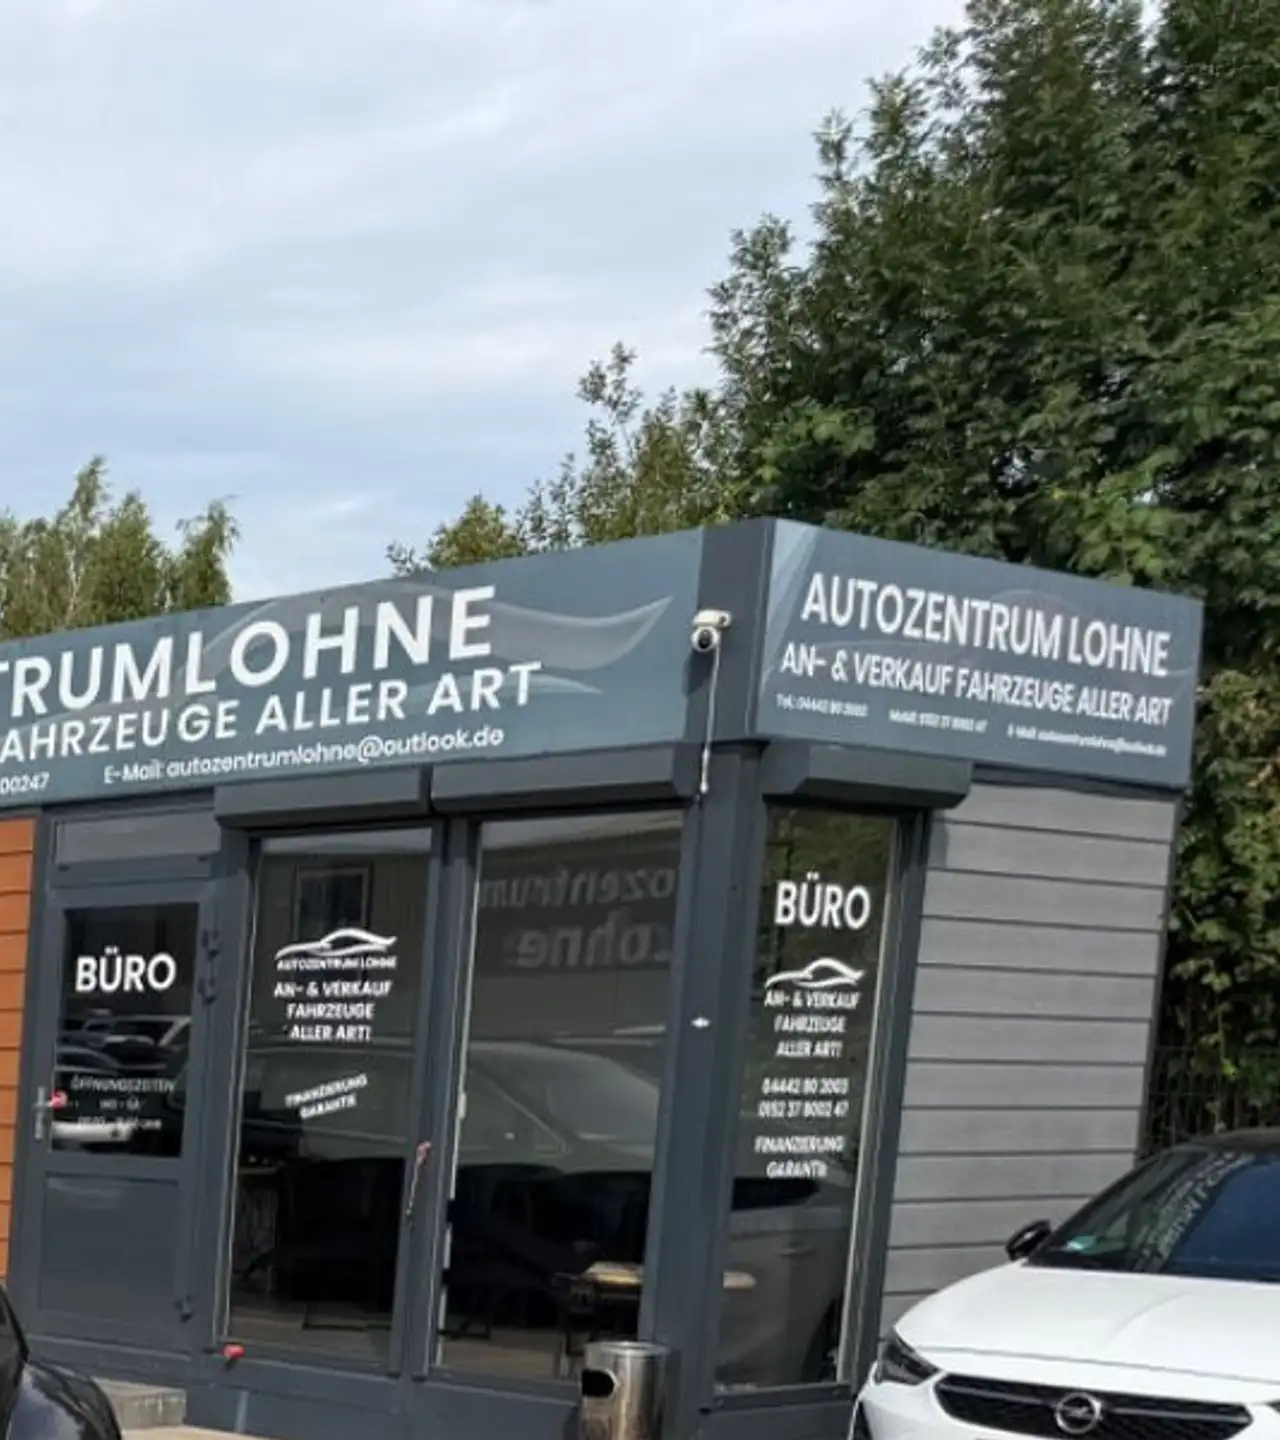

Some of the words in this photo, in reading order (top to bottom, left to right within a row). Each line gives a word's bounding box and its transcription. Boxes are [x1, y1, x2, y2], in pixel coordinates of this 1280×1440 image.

[801, 572, 1061, 660] AUTOZENTRUM
[1068, 616, 1170, 677] LOHNE
[256, 679, 408, 734] ALLER
[429, 661, 540, 715] ART
[780, 643, 827, 677] AN-
[831, 651, 848, 682] &
[854, 653, 953, 696] VERKAUF
[956, 667, 1074, 713] FAHRZEUGE
[1077, 686, 1130, 721] ALLER
[1134, 696, 1173, 727] ART
[104, 756, 162, 784] E-Mail:
[166, 725, 504, 780] autozentrumlohne@outlook.de
[775, 872, 871, 930] BÜRO
[75, 946, 176, 992] BÜRO
[274, 981, 303, 998] AN-
[306, 981, 318, 997] &
[322, 980, 393, 997] VERKAUF
[286, 1002, 376, 1020] FAHRZEUGE
[291, 1025, 333, 1041] ALLER
